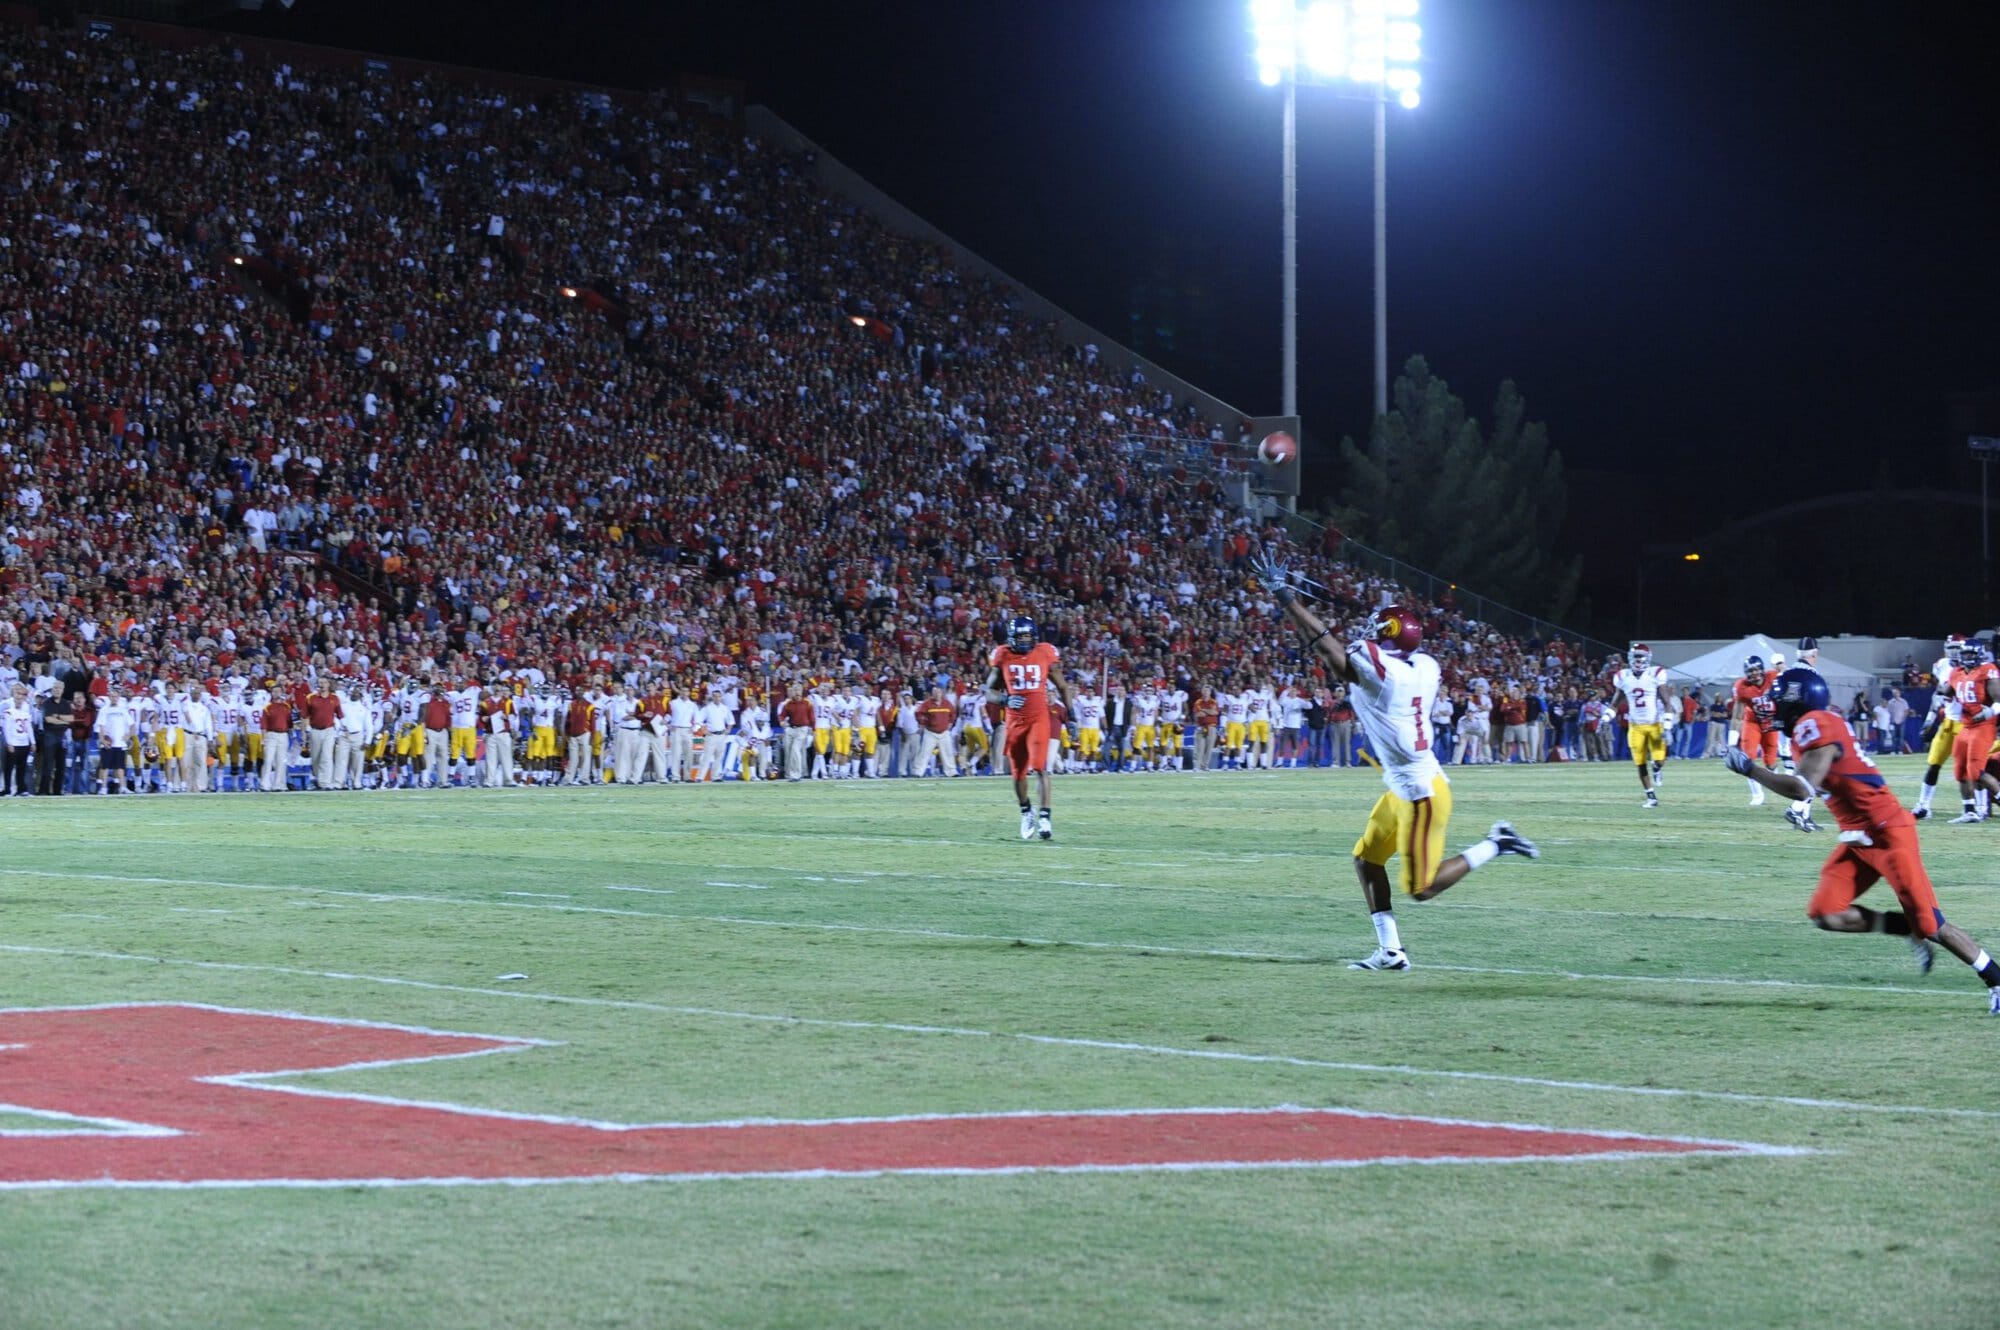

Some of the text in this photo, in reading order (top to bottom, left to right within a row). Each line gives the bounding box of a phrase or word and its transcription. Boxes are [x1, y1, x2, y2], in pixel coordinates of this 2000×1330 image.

[1009, 664, 1041, 690] 33
[1632, 687, 1646, 708] 2
[163, 710, 179, 725] 15
[1411, 696, 1428, 752] 1
